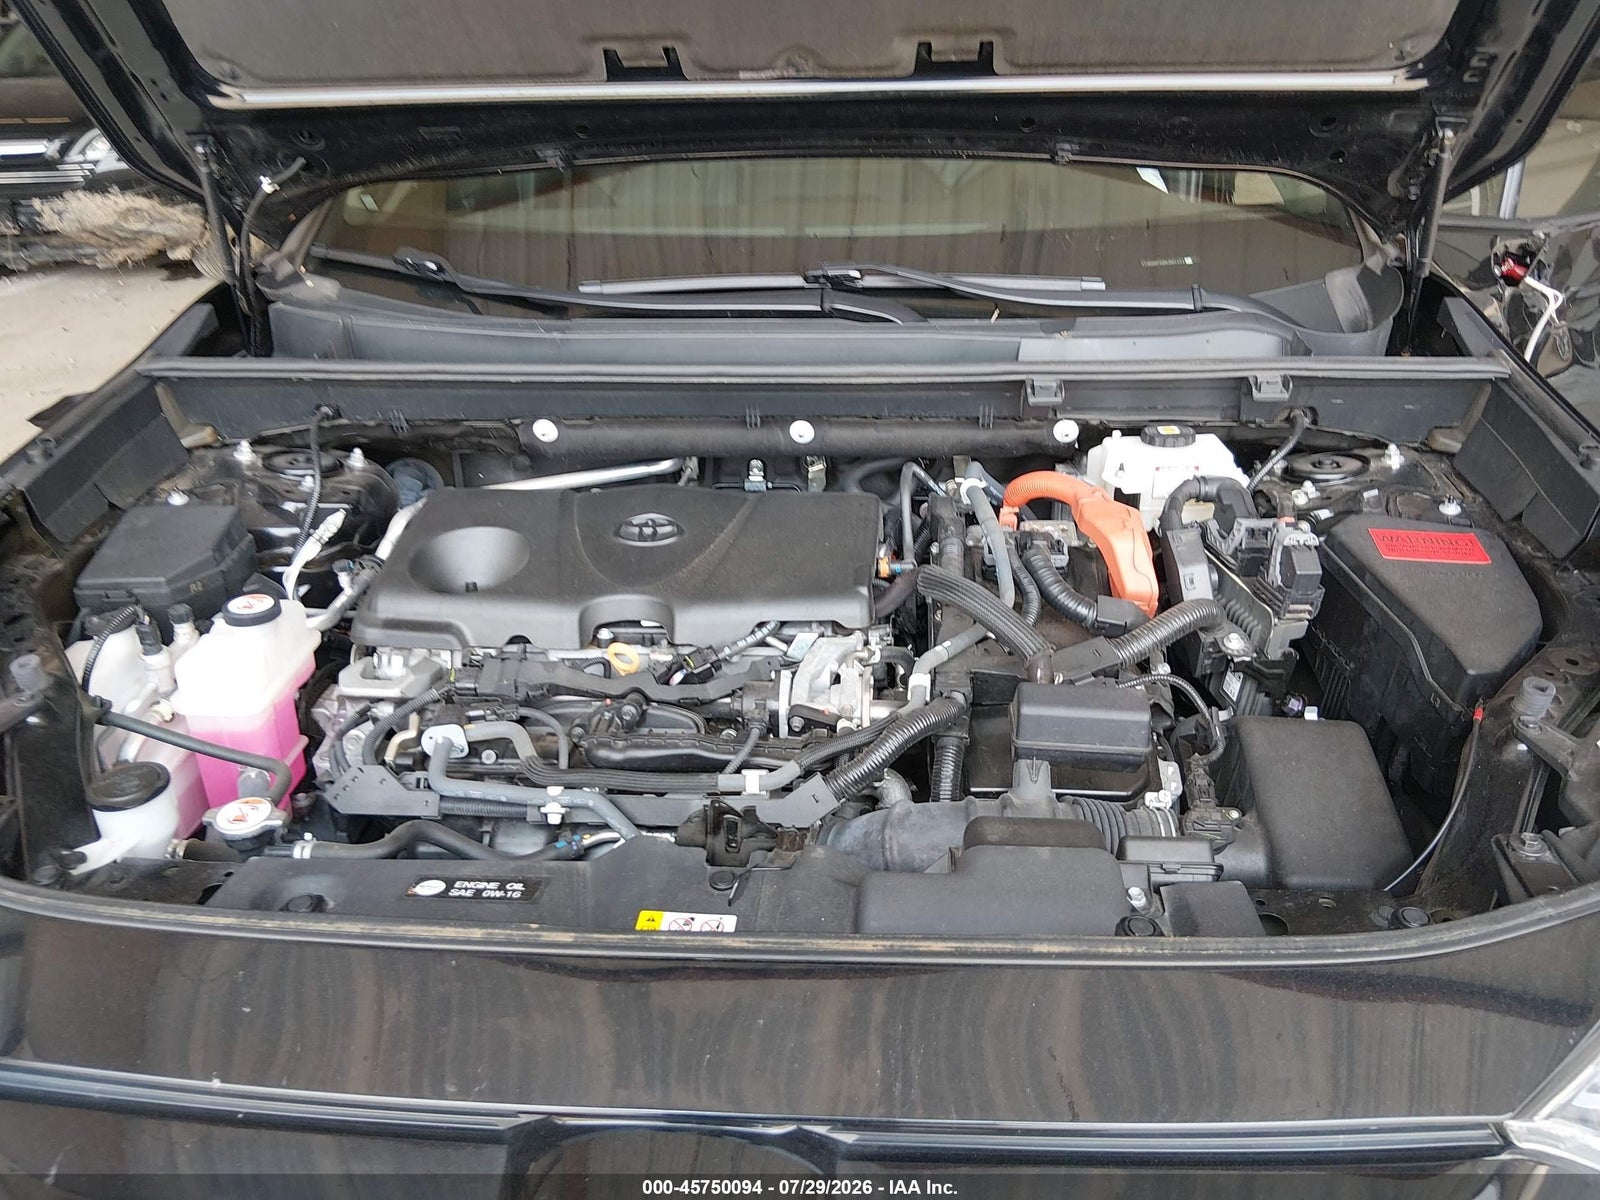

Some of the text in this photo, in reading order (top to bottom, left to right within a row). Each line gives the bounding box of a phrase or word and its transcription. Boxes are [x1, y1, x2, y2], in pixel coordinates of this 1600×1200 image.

[454, 880, 526, 891] ENGINE OIL
[448, 888, 522, 899] SAE 0W-16
